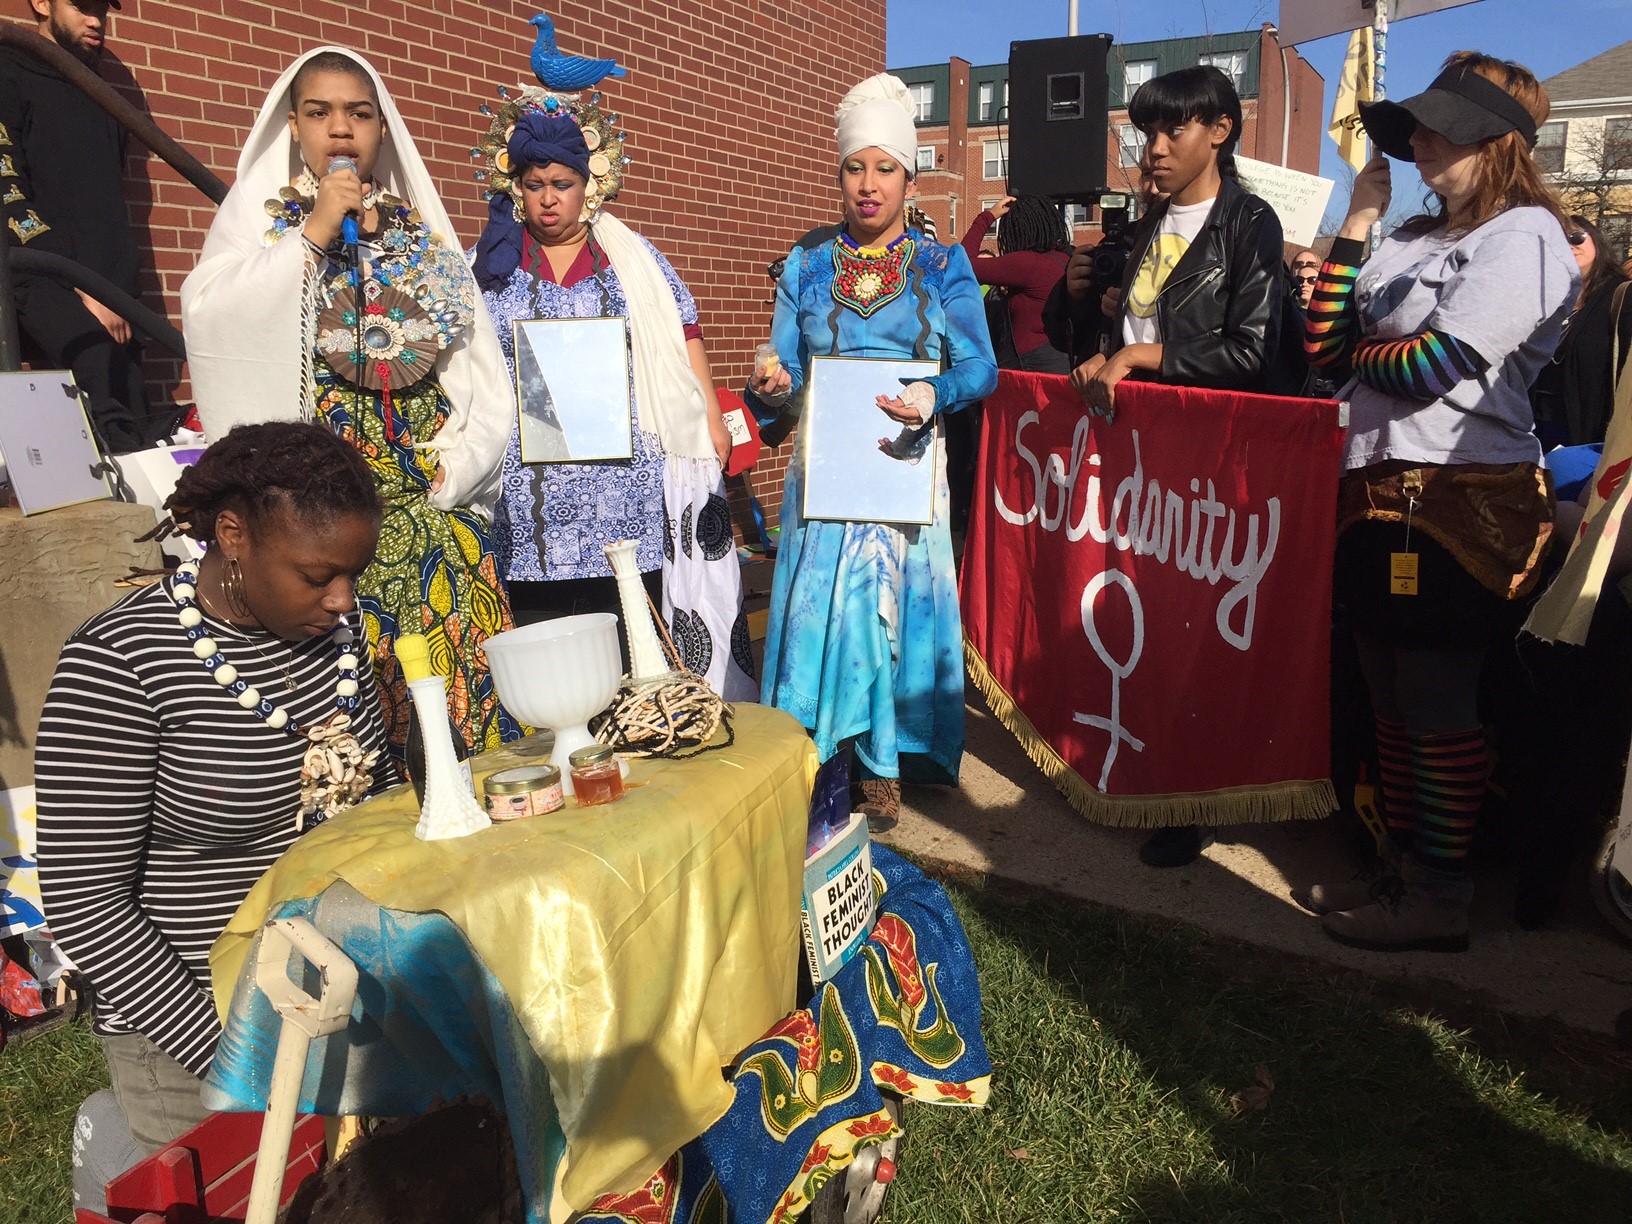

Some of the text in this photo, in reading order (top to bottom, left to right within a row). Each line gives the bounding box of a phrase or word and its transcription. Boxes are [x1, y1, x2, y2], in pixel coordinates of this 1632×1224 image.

[1289, 183, 1298, 193] IS
[1299, 187, 1318, 196] NOT
[994, 410, 1280, 651] Solidarity
[822, 873, 869, 934] FEMINIST
[827, 858, 864, 906] BLACK
[801, 911, 812, 939] BLACK
[807, 941, 820, 979] FEMINIST
[823, 893, 872, 957] THOUGHT
